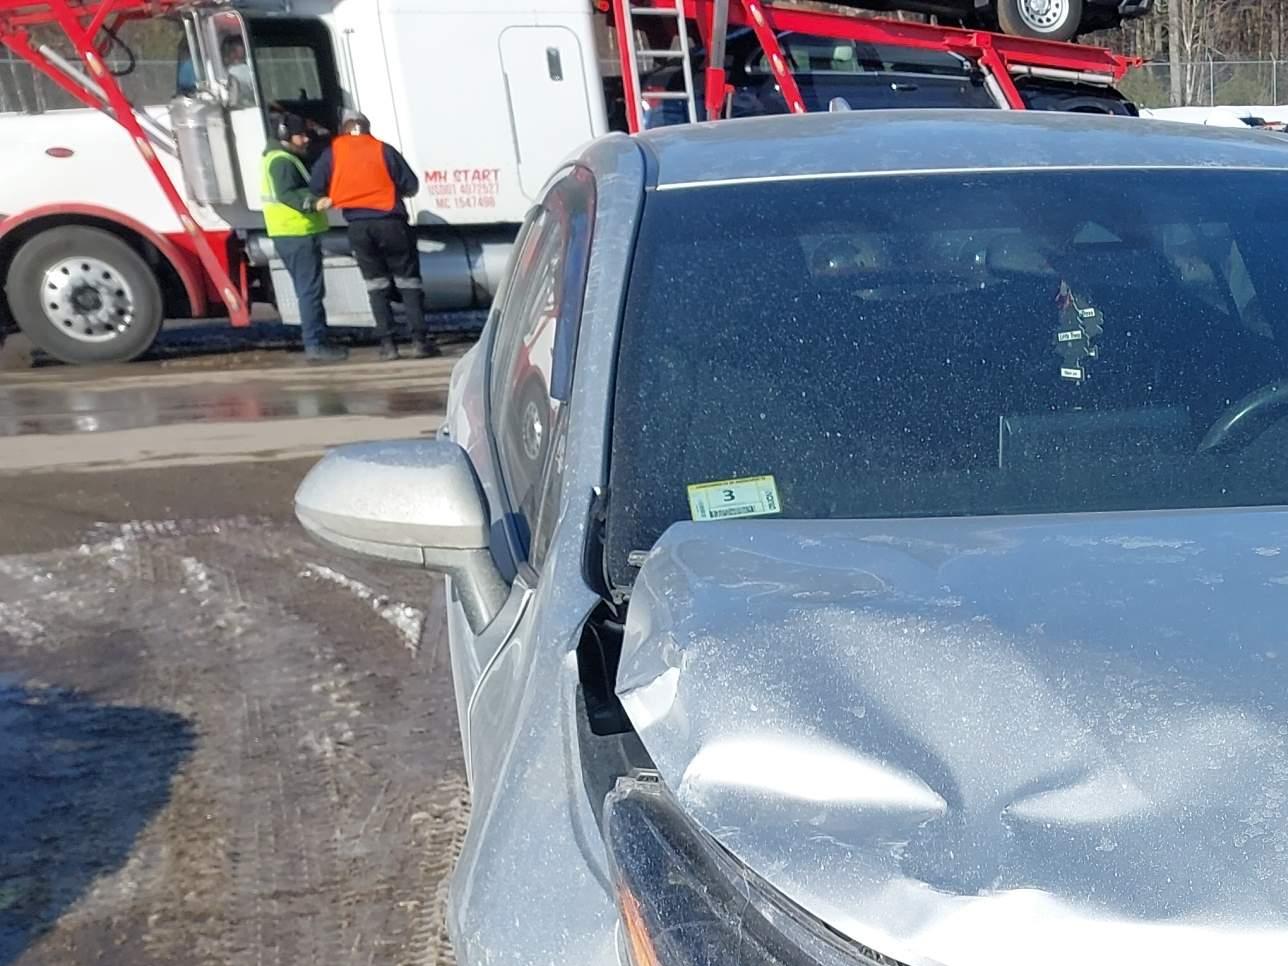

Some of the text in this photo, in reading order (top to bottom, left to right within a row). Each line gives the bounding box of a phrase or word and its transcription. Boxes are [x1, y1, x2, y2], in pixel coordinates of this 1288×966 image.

[424, 168, 501, 183] MH START
[722, 489, 736, 502] 3
